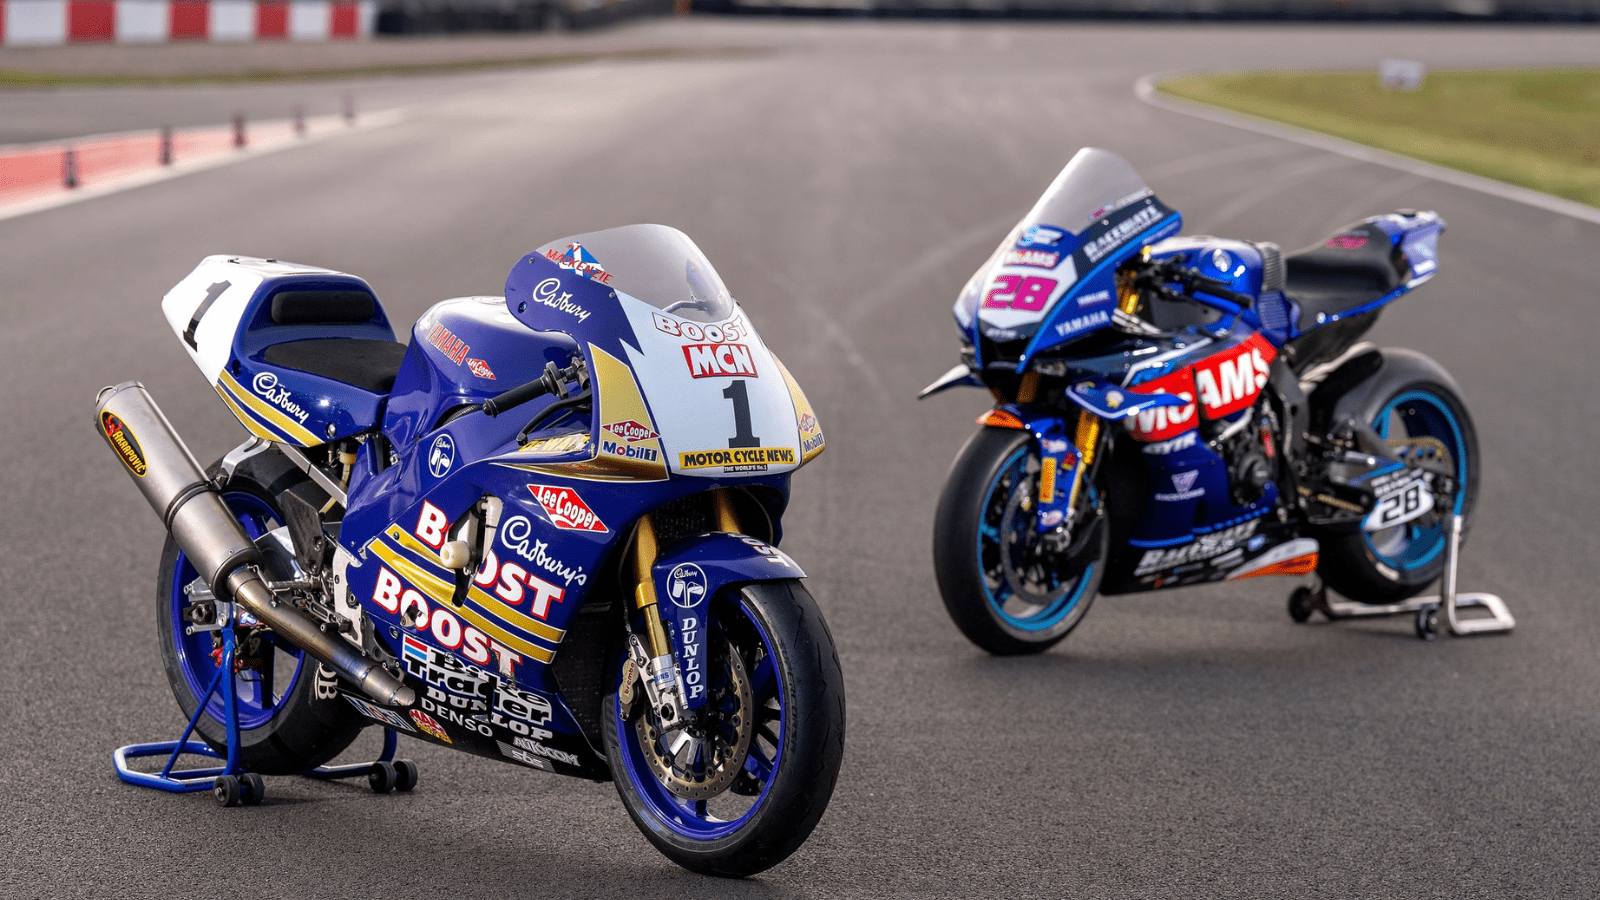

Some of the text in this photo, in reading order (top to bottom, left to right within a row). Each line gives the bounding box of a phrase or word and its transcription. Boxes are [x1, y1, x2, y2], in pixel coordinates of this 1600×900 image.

[545, 249, 614, 285] MACKENZIE
[533, 278, 591, 323] Cadbury
[981, 274, 1058, 312] 28
[183, 280, 232, 352] 1
[652, 313, 747, 343] BOOST
[426, 321, 470, 366] YAMAHA
[688, 345, 755, 375] MCN
[253, 372, 309, 424] Cadbury
[722, 380, 760, 448] 1
[684, 449, 794, 467] MOTOR CYCLE NEWS
[1382, 486, 1419, 523] 28
[415, 500, 565, 620] BOST
[501, 515, 587, 587] Cadbury's
[674, 568, 697, 578] Cadbury
[372, 565, 523, 677] BOOST
[624, 662, 635, 694] brembo
[682, 618, 704, 698] DUNLOP
[403, 651, 552, 725] Tracer
[421, 697, 493, 737] DENSO
